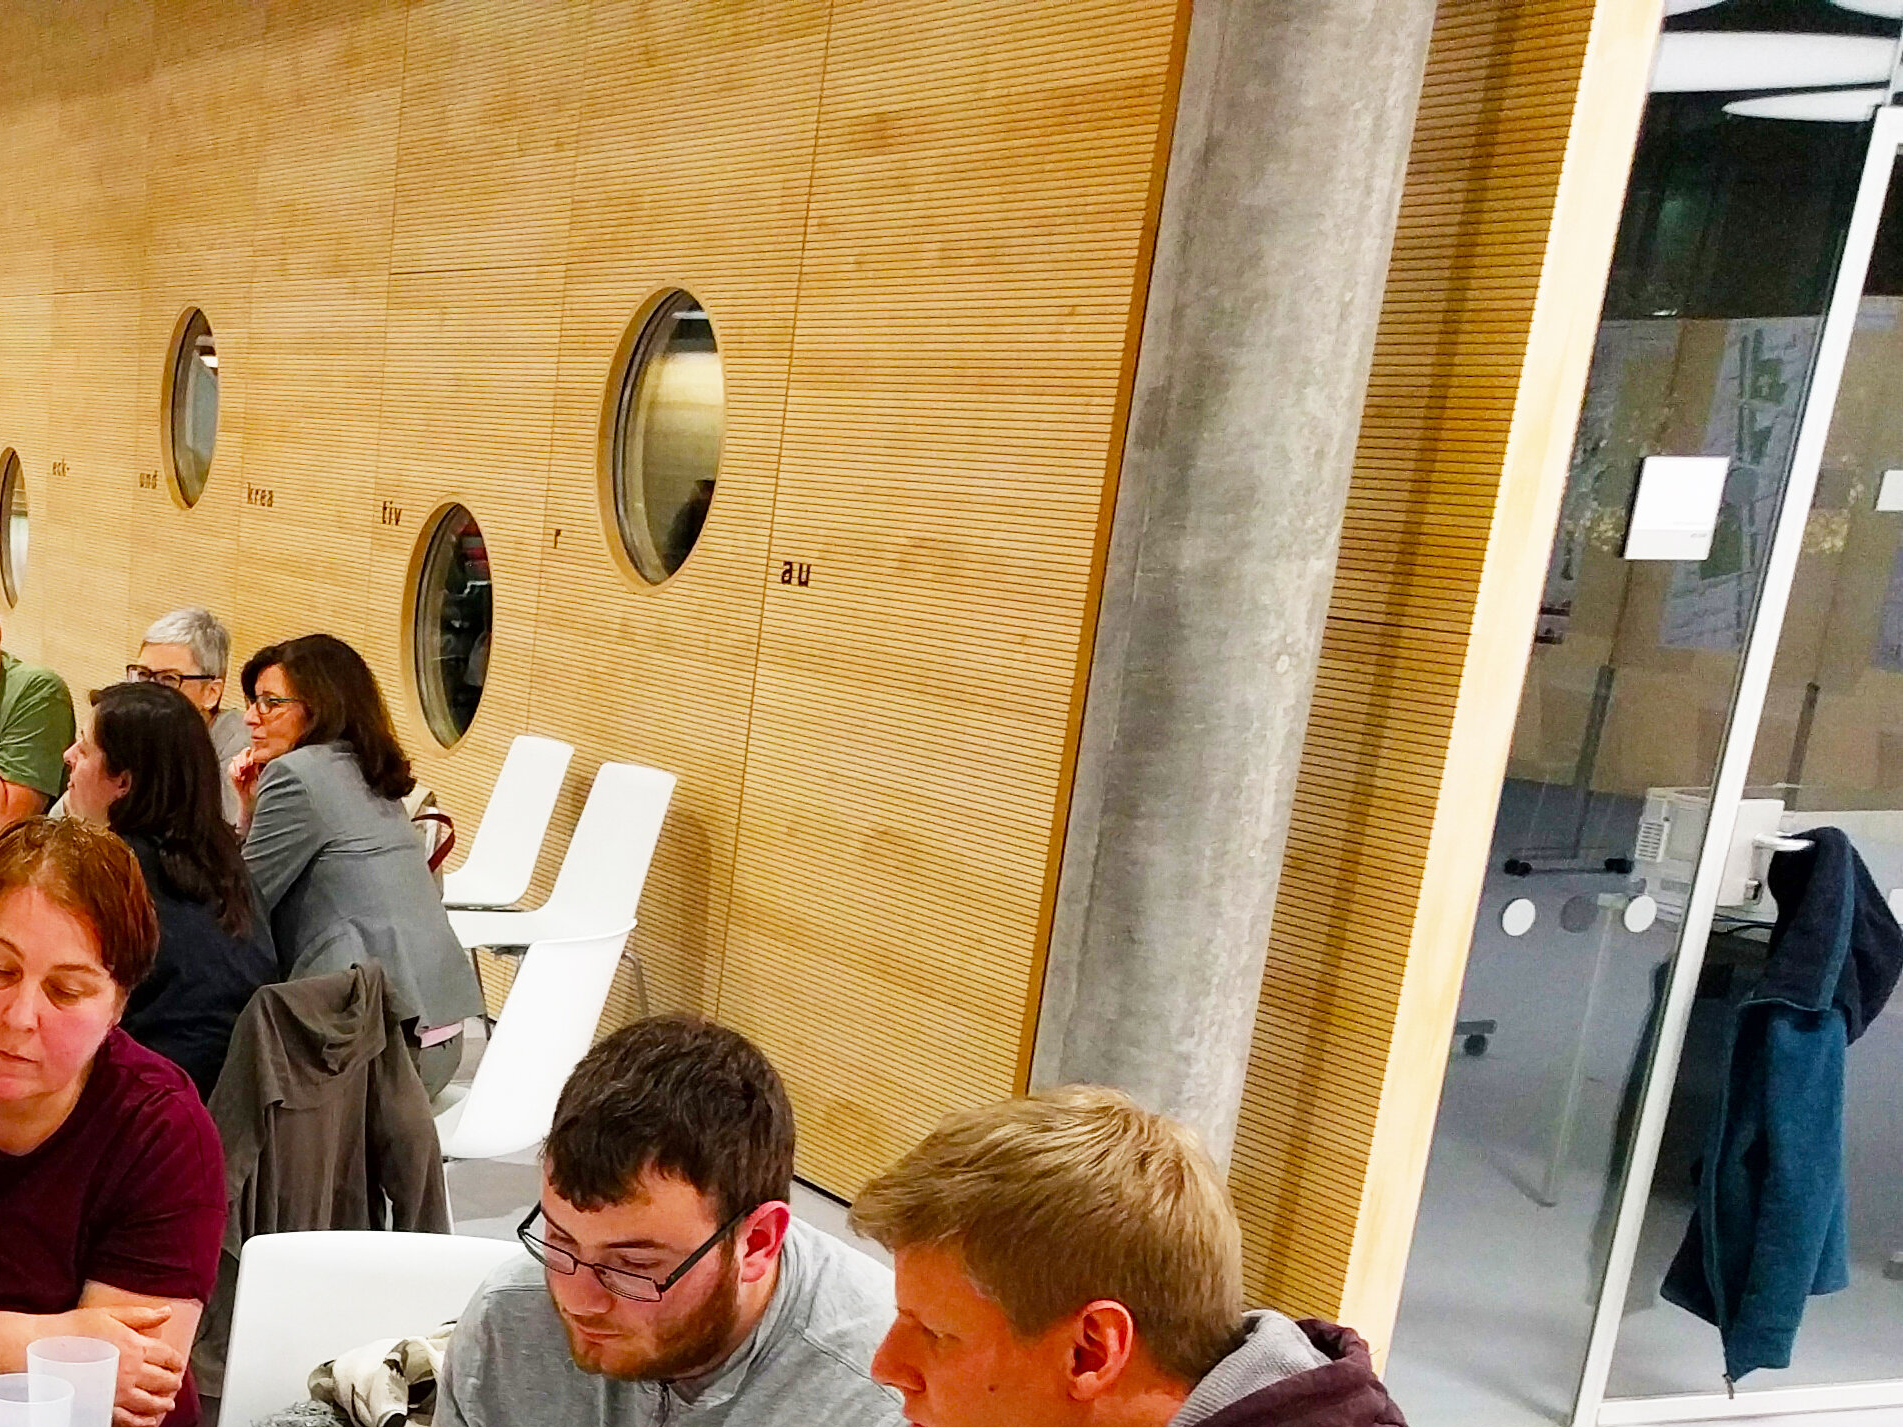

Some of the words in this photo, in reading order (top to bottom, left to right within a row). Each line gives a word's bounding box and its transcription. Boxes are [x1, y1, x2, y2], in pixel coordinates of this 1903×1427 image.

[247, 482, 274, 507] krea
[381, 500, 402, 526] tiv
[781, 561, 812, 587] au
